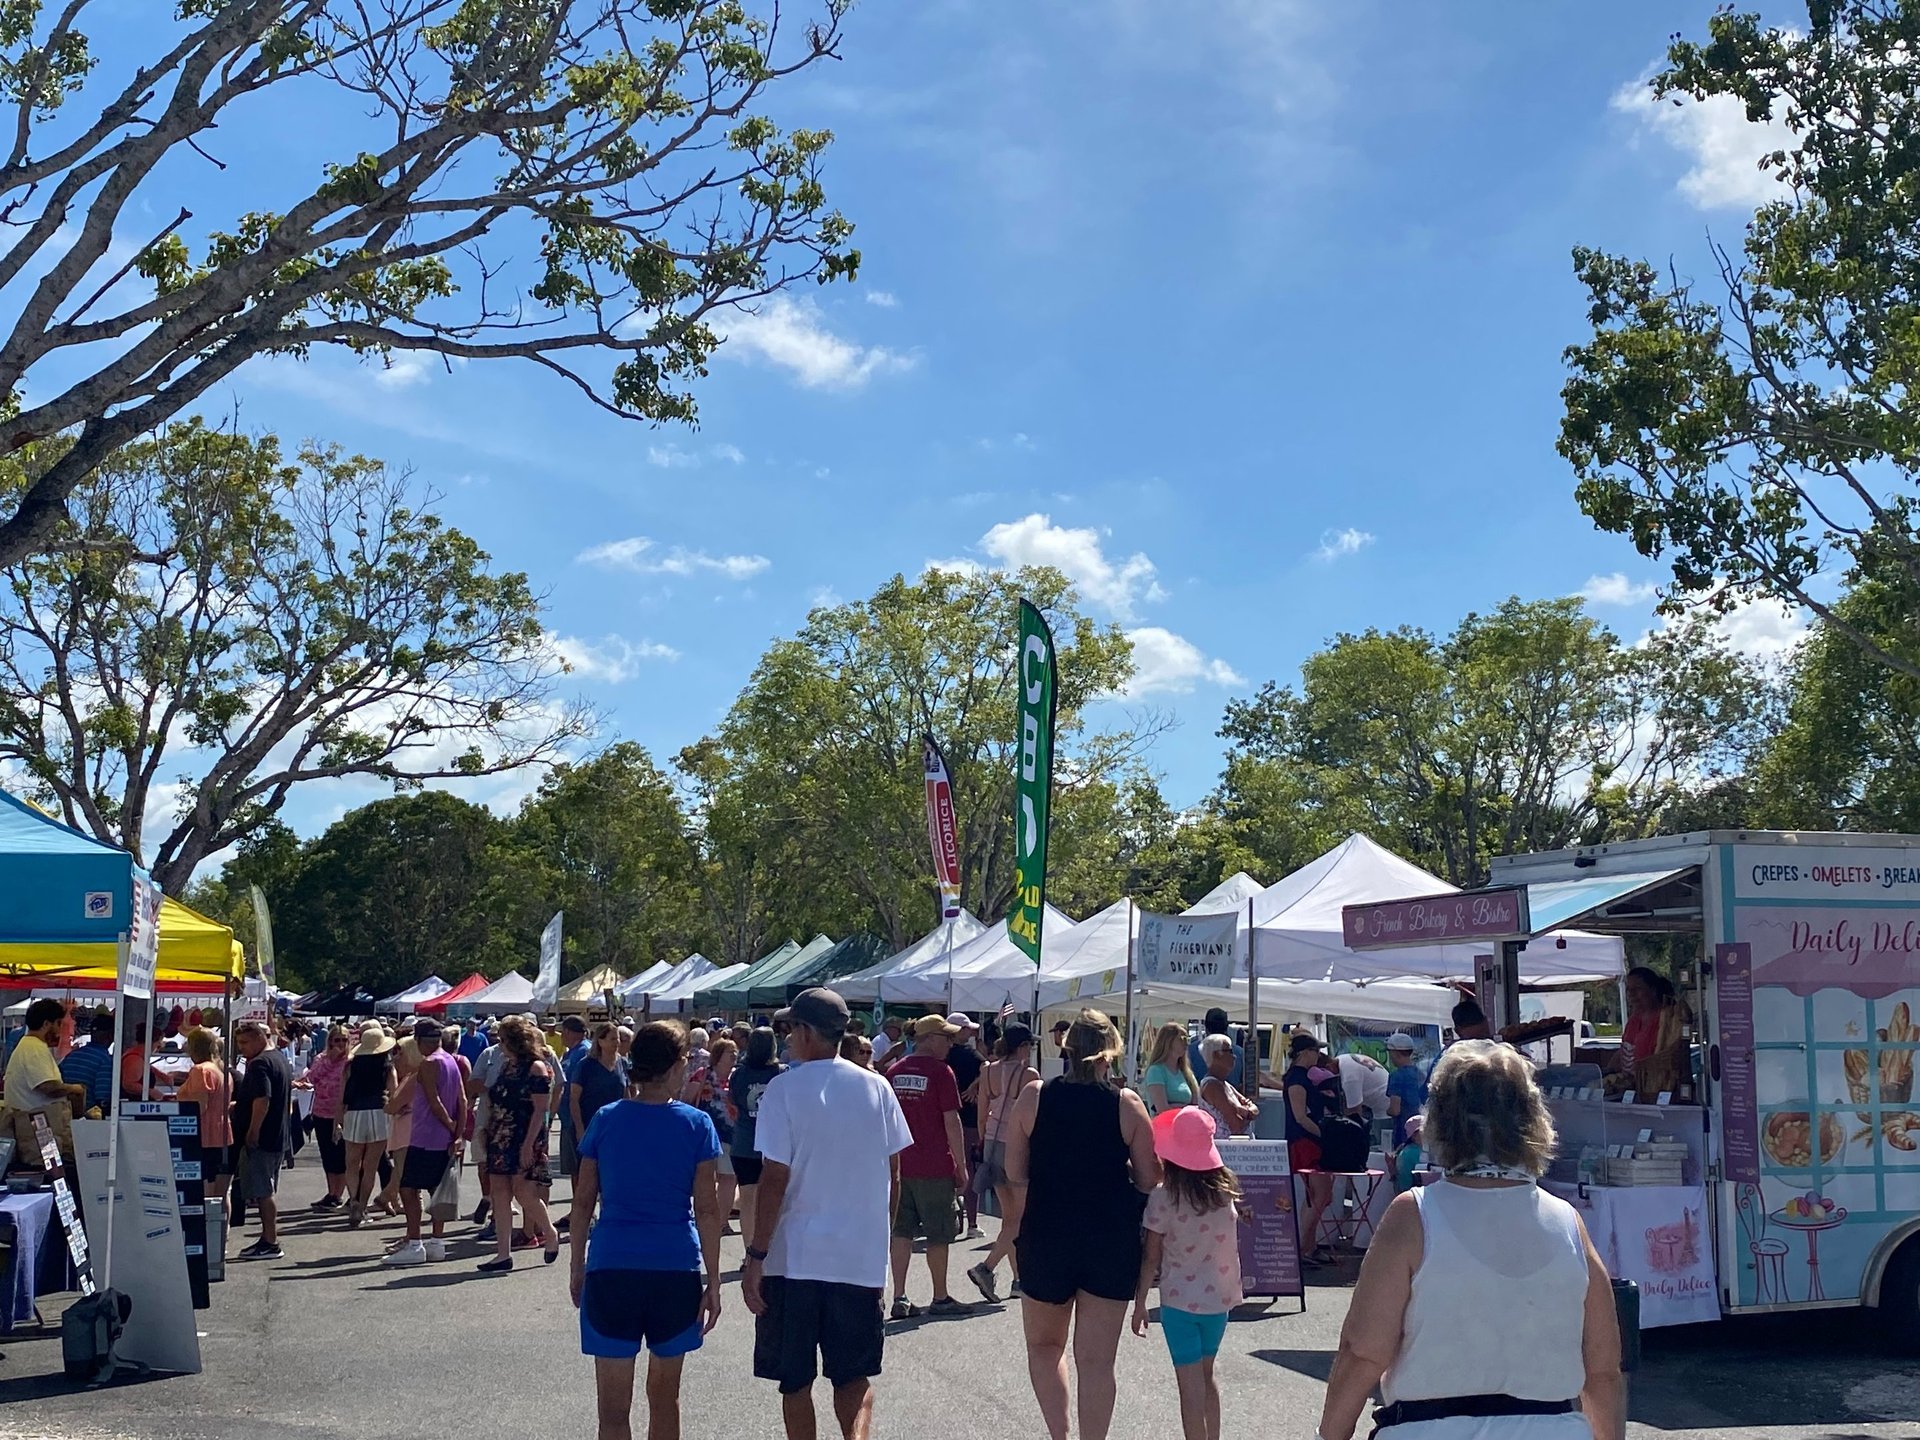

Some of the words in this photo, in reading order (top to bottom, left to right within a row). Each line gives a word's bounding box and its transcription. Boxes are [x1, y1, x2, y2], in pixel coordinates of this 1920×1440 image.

[940, 797, 957, 868] LICORICE
[1752, 865, 1799, 885] CREPES
[1811, 866, 1871, 887] OMELETS
[1369, 909, 1403, 937] French
[1409, 903, 1448, 936] Bakery
[1454, 903, 1465, 930] &
[1472, 897, 1511, 925] Bistro
[1176, 923, 1193, 936] THE
[1169, 941, 1232, 957] FISHERMAN'S
[1791, 919, 1862, 966] Daily
[1170, 960, 1218, 976] DAUGHTER
[140, 1103, 161, 1113] DIPS
[1242, 1145, 1273, 1153] OMELET
[1274, 1145, 1286, 1153] $10
[1643, 1278, 1675, 1300] Daily
